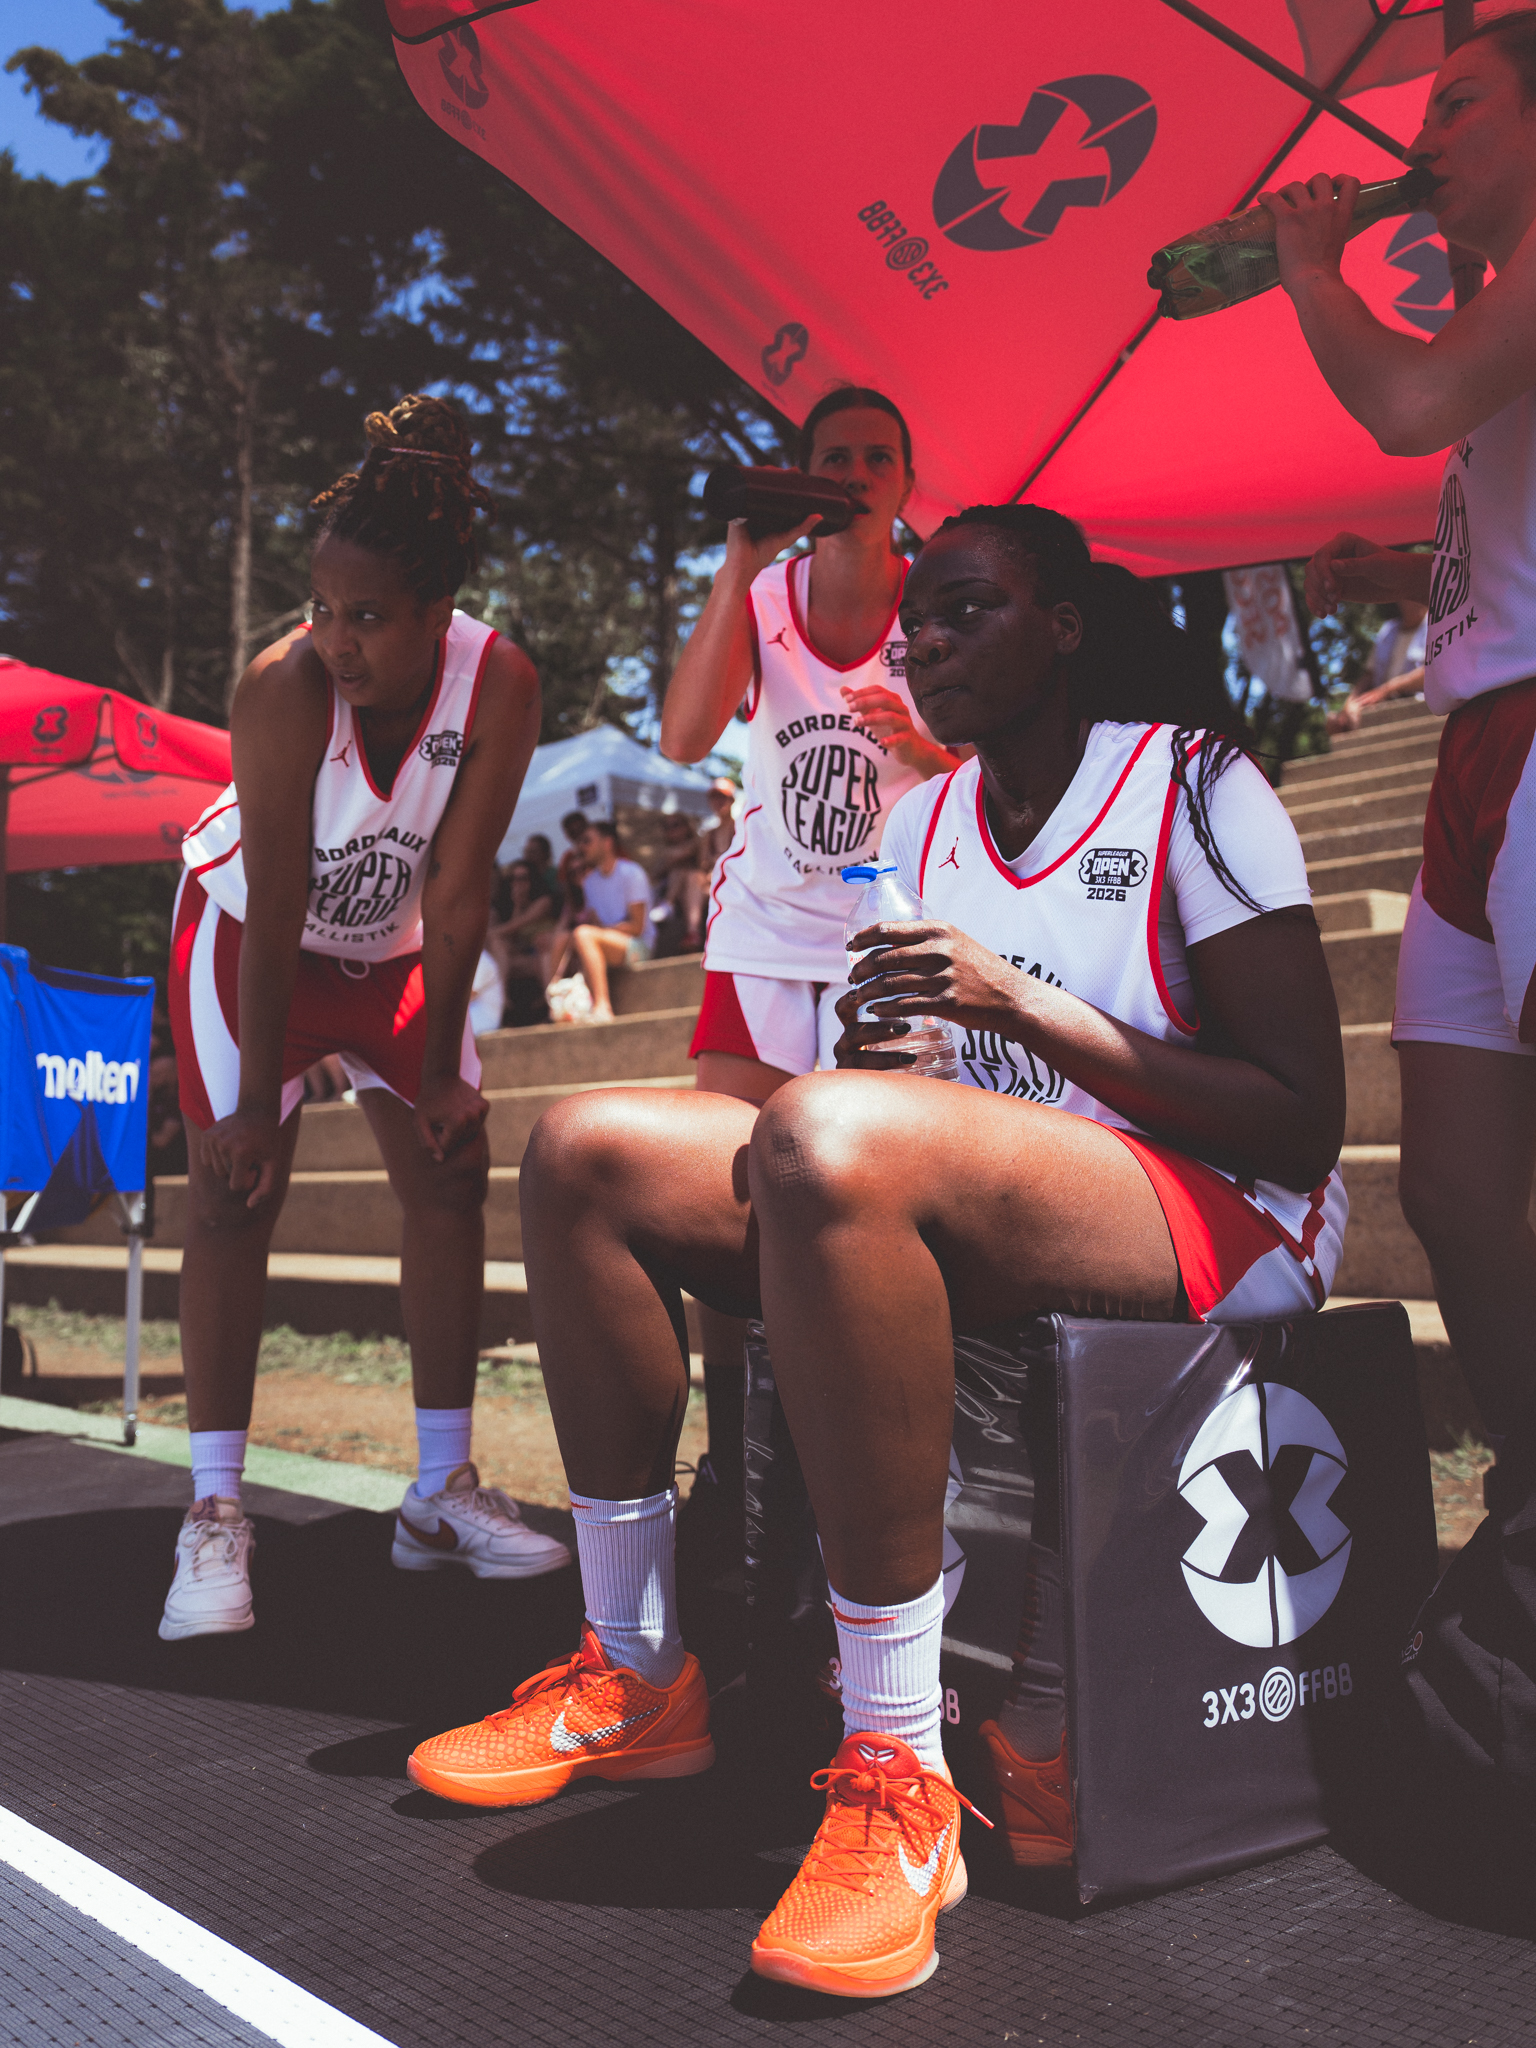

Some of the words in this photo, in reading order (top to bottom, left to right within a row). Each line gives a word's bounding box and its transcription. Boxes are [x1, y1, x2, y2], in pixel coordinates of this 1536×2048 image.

[781, 744, 881, 812] SUPER
[781, 788, 882, 856] LEAGUE
[1086, 887, 1127, 902] 2026
[1091, 857, 1131, 877] OPEN
[1202, 1682, 1256, 1728] 3X3
[1298, 1662, 1353, 1707] FFBB
